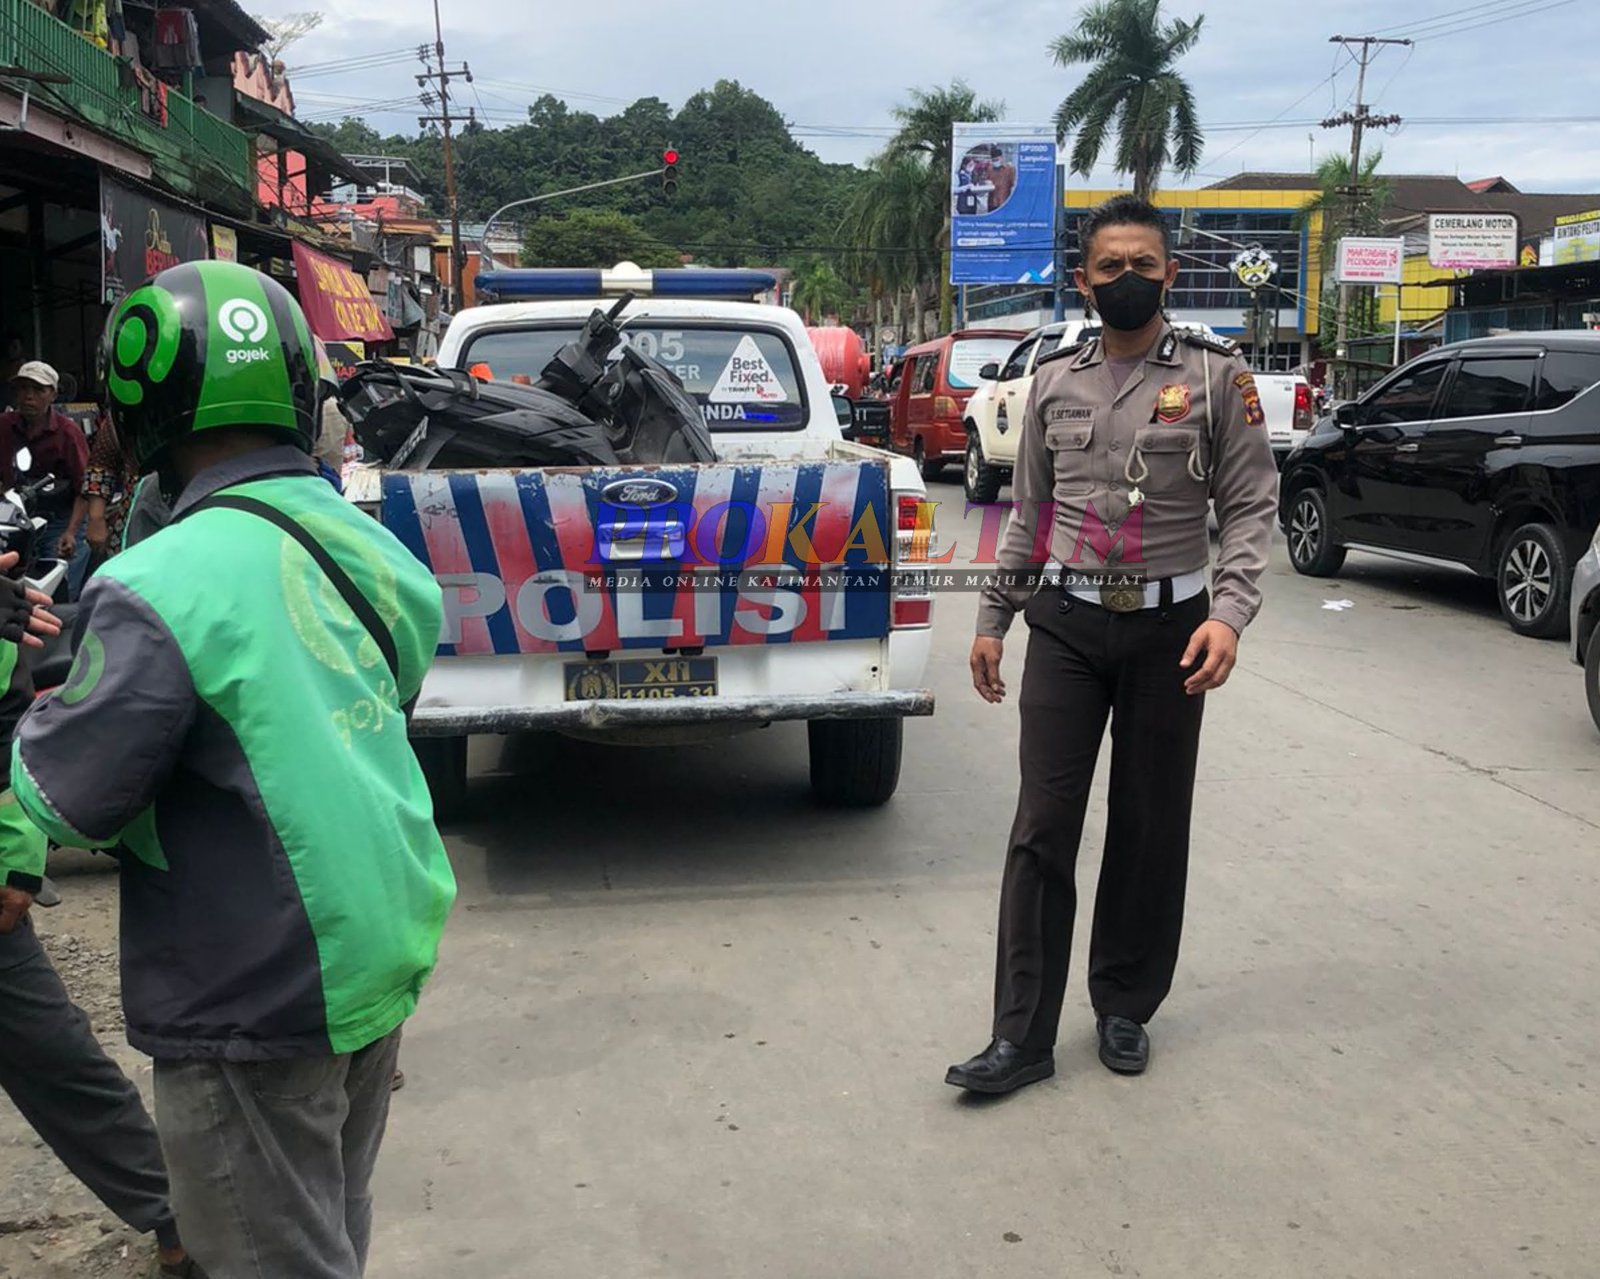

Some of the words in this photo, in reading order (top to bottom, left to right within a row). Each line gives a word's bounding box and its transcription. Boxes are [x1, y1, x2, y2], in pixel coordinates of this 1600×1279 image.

[1434, 218, 1484, 229] CEMERLANG
[1485, 218, 1514, 229] MOTOR
[225, 347, 270, 364] gojek
[732, 357, 764, 370] Best
[619, 484, 660, 502] Ford
[434, 563, 846, 644] POLISI
[644, 661, 690, 683] XII
